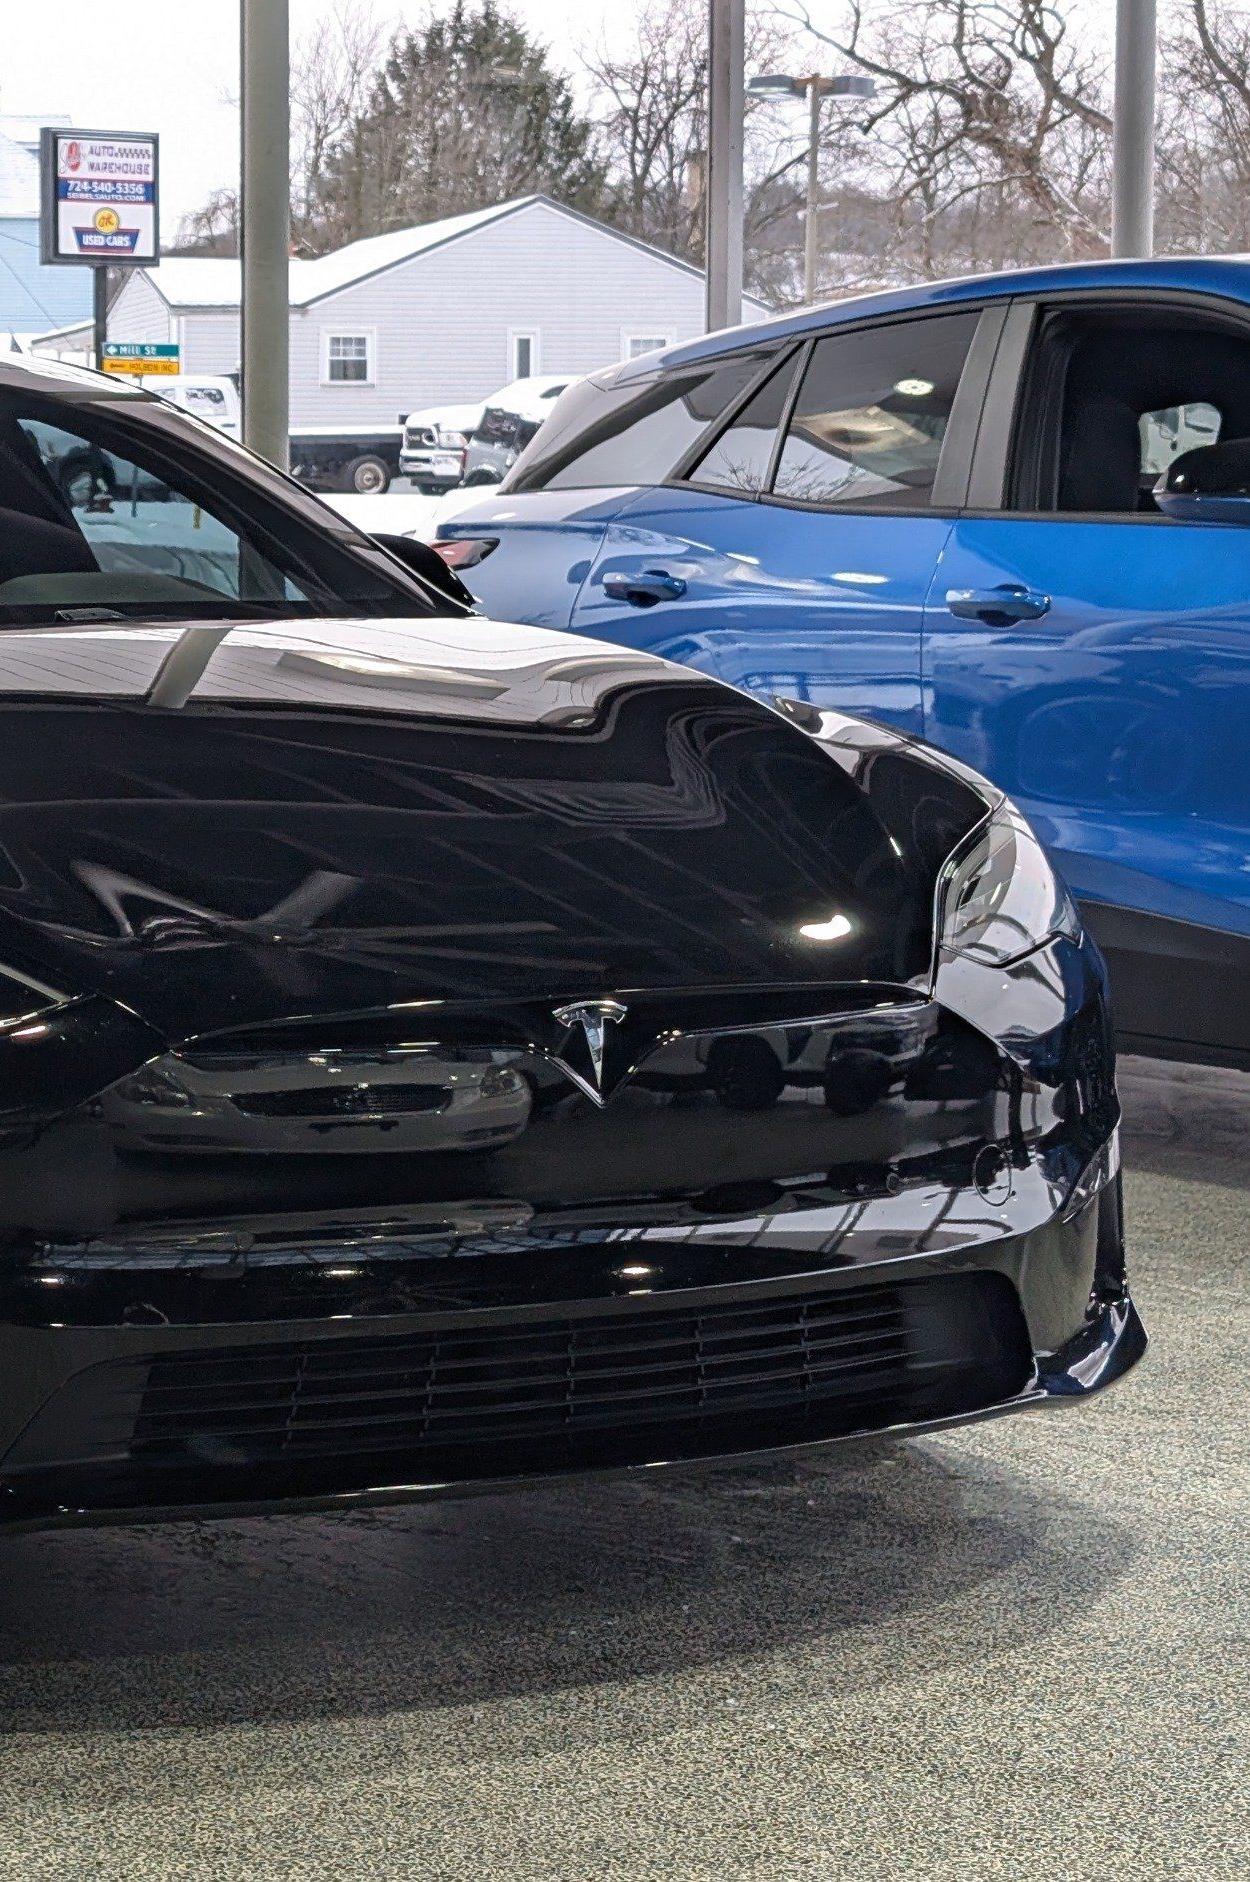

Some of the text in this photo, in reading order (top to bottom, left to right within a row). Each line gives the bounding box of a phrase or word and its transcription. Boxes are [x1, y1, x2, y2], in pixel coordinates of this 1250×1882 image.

[88, 145, 114, 157] AUTO
[88, 162, 150, 175] WAREHOUSE
[67, 181, 145, 194] 724-540-5356
[82, 235, 131, 247] USED CARS
